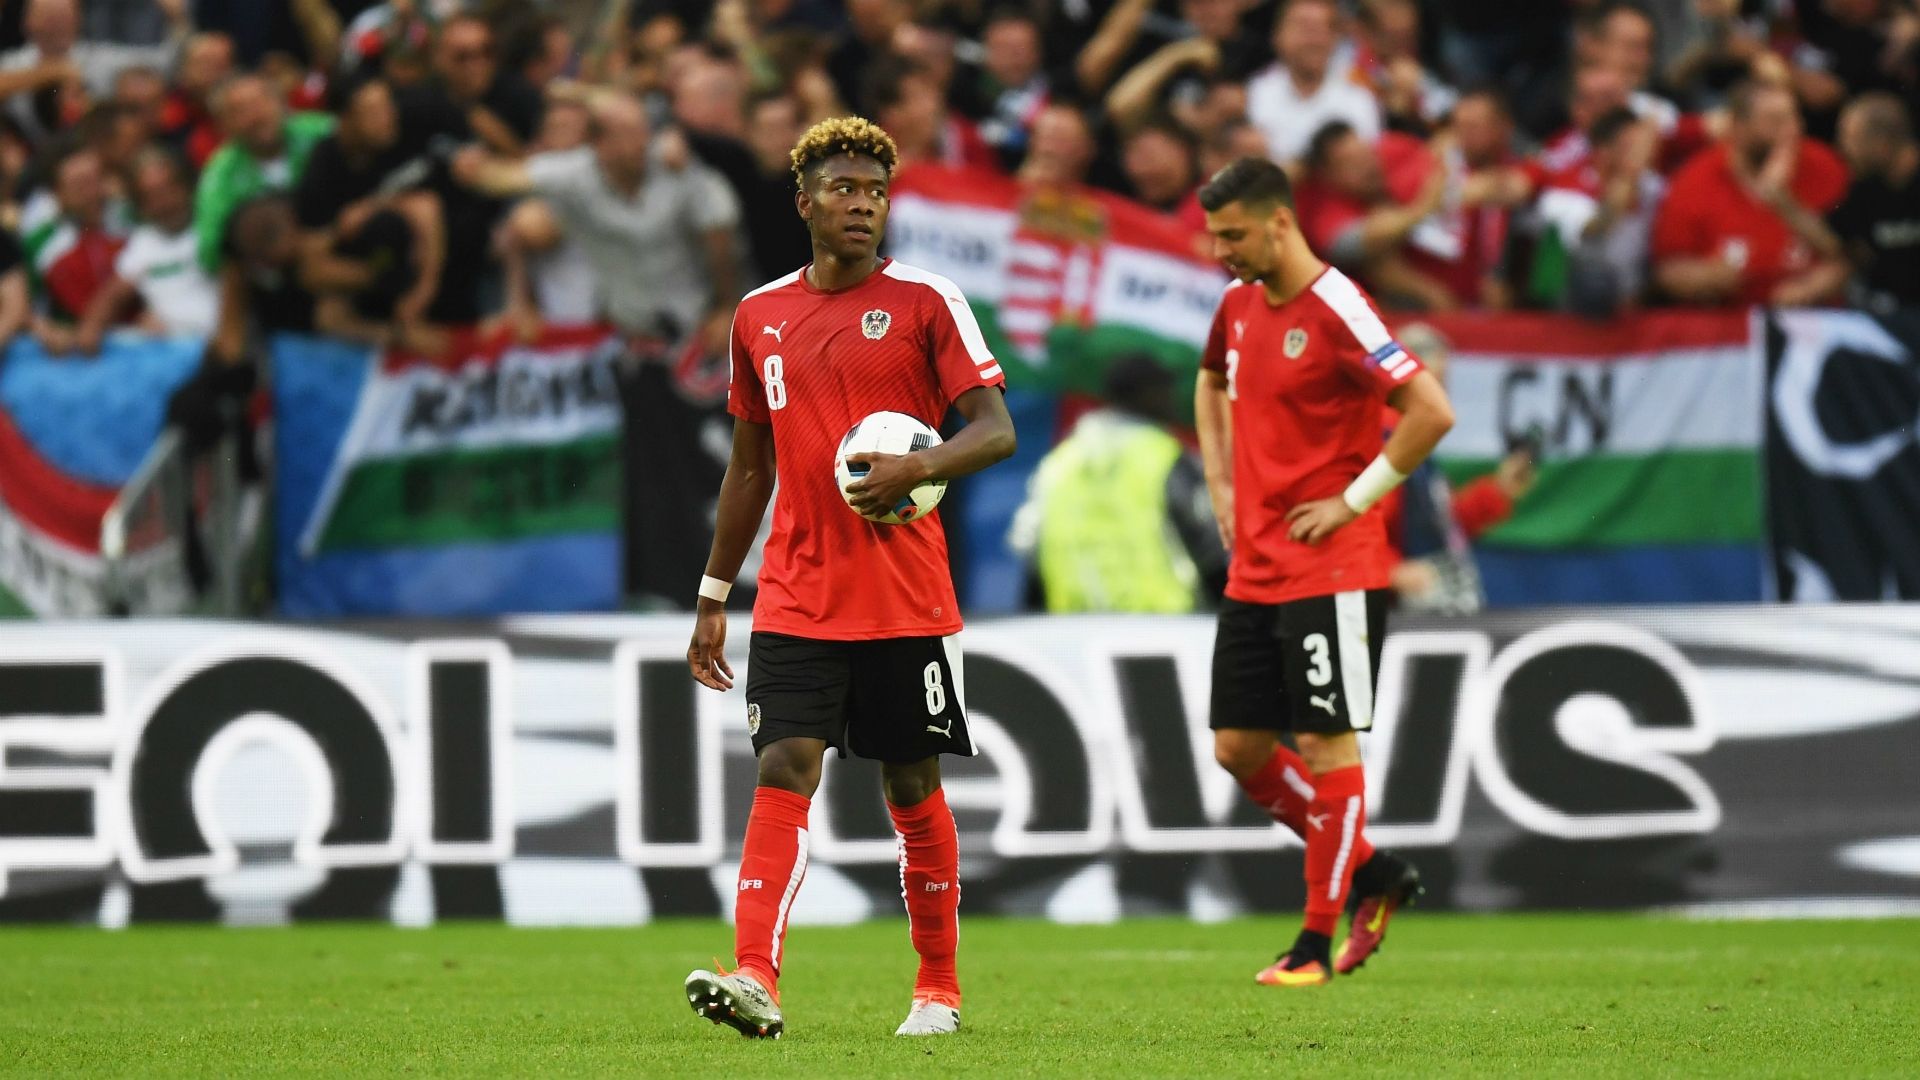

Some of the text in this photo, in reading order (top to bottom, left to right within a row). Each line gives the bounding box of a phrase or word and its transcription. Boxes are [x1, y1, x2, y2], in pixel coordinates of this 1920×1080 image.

[763, 354, 788, 411] 8
[1302, 632, 1333, 687] 3
[923, 660, 947, 716] 8
